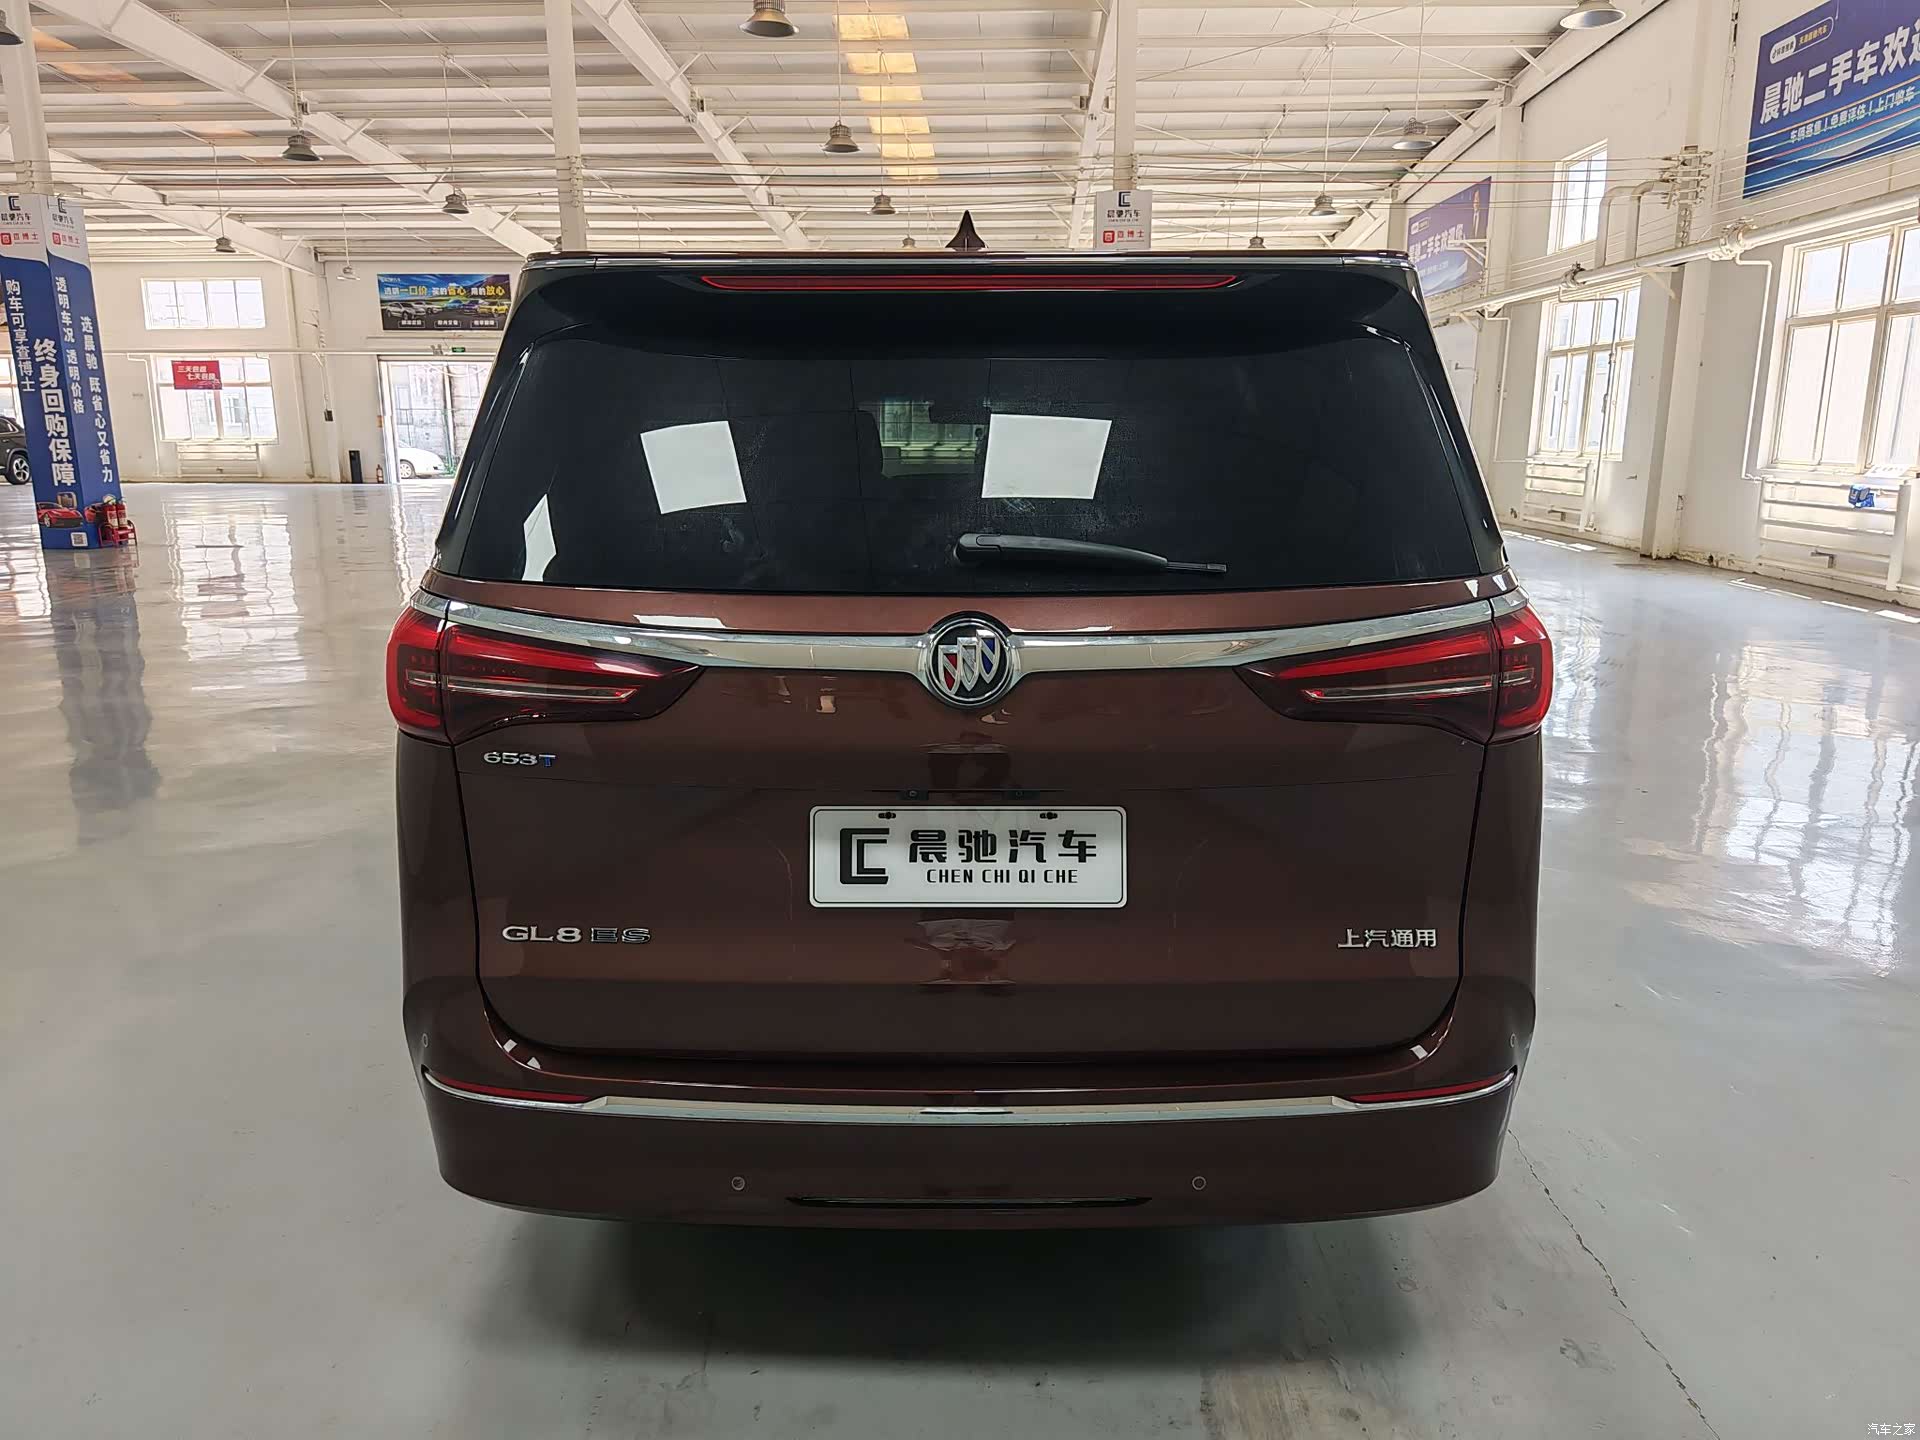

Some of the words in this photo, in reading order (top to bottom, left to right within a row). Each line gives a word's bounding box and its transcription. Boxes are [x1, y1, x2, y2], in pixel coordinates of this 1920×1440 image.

[5, 280, 35, 392] 购车可享查博士
[55, 276, 76, 343] 透明车况
[66, 349, 85, 415] 透明价格
[33, 338, 76, 487] 终身回购保障
[89, 376, 113, 483] 既省心又省力
[483, 751, 556, 768] 653T
[908, 829, 1097, 863] 晨驰汽车
[926, 869, 973, 883] CHEN
[981, 869, 1010, 883] CHI
[1018, 869, 1035, 883] QI
[1043, 869, 1078, 883] CHE
[502, 925, 582, 943] GL8
[590, 927, 650, 943] ES
[1337, 928, 1437, 948] 上汽通用
